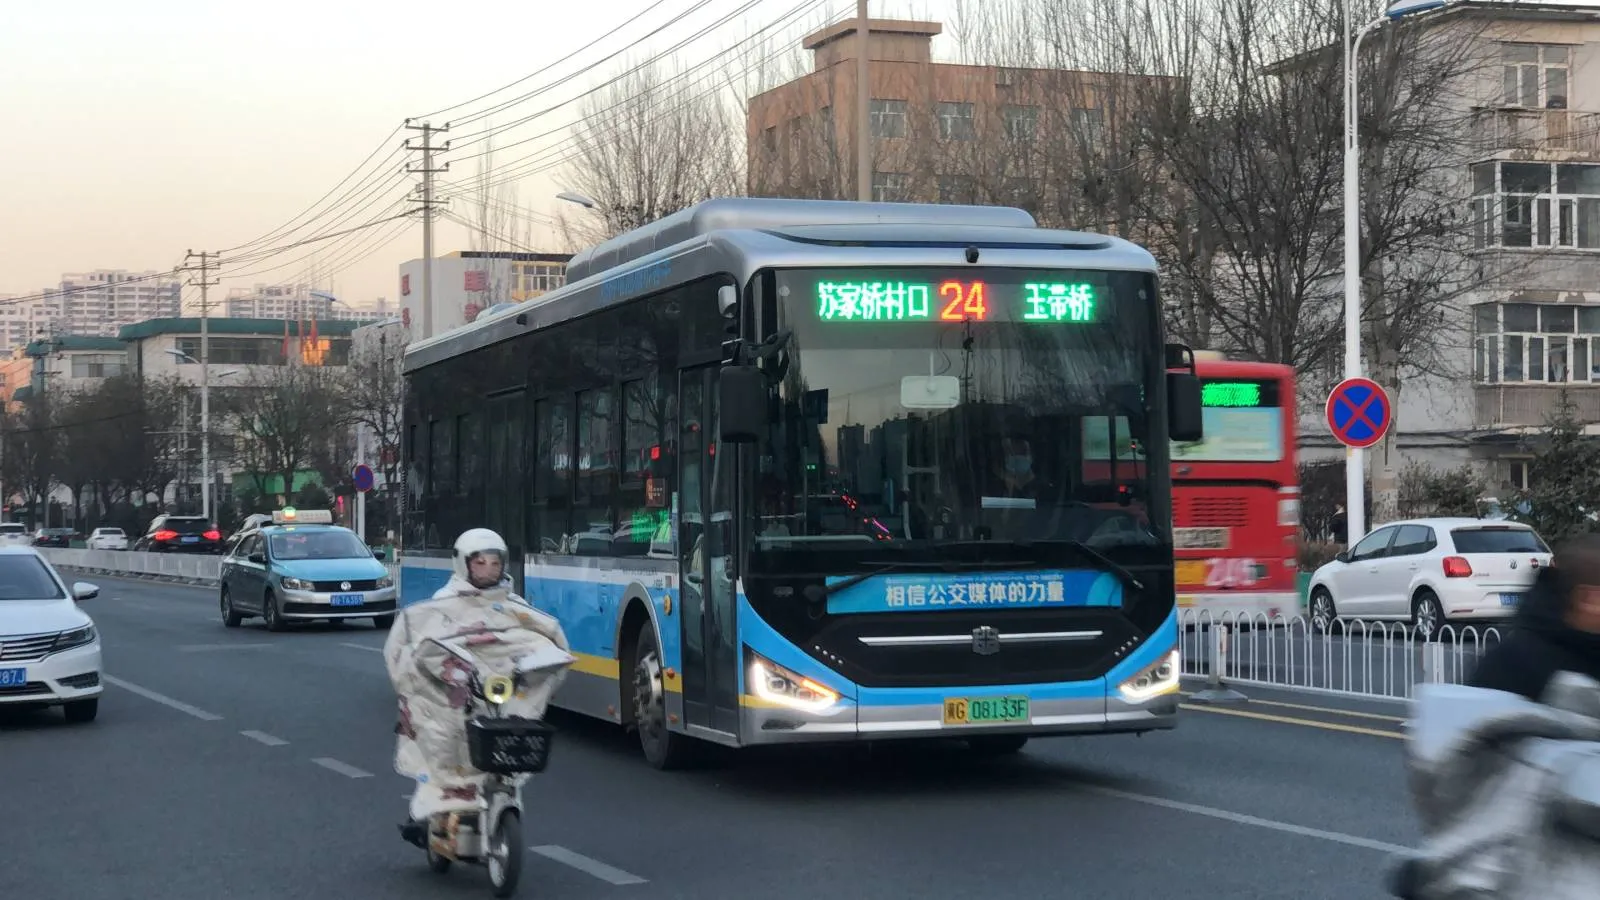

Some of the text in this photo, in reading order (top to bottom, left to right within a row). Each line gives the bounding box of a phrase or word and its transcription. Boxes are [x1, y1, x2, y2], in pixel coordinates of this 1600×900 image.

[818, 282, 1093, 320] 苏家桥村口 24 玉带桥
[886, 581, 1065, 607] 相信公交媒体的力量
[0, 670, 25, 685] 87J
